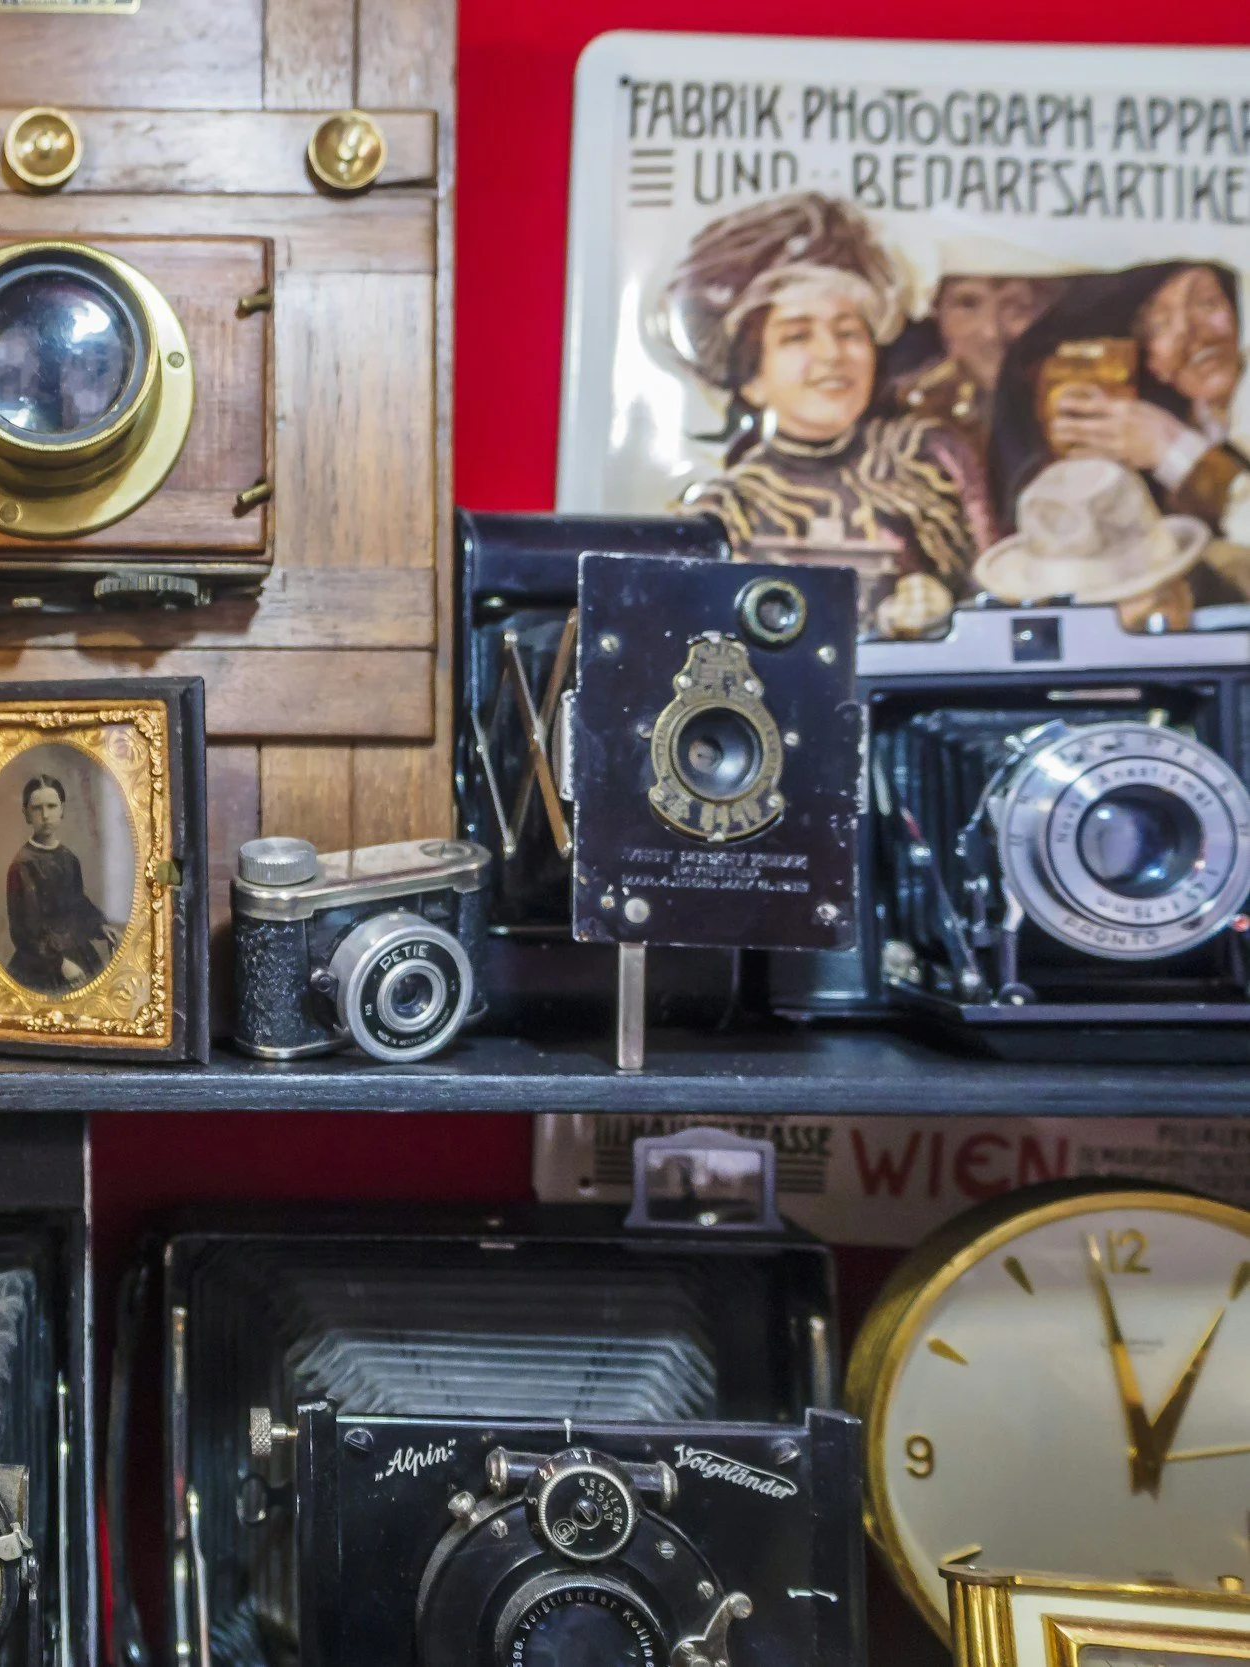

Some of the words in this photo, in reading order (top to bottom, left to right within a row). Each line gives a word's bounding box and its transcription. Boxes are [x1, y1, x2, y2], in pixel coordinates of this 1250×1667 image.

[630, 82, 783, 139] FABRIK
[694, 150, 799, 206] UND
[379, 944, 430, 972] PETIE
[1105, 1227, 1152, 1274] 12
[905, 1434, 935, 1479] 9
